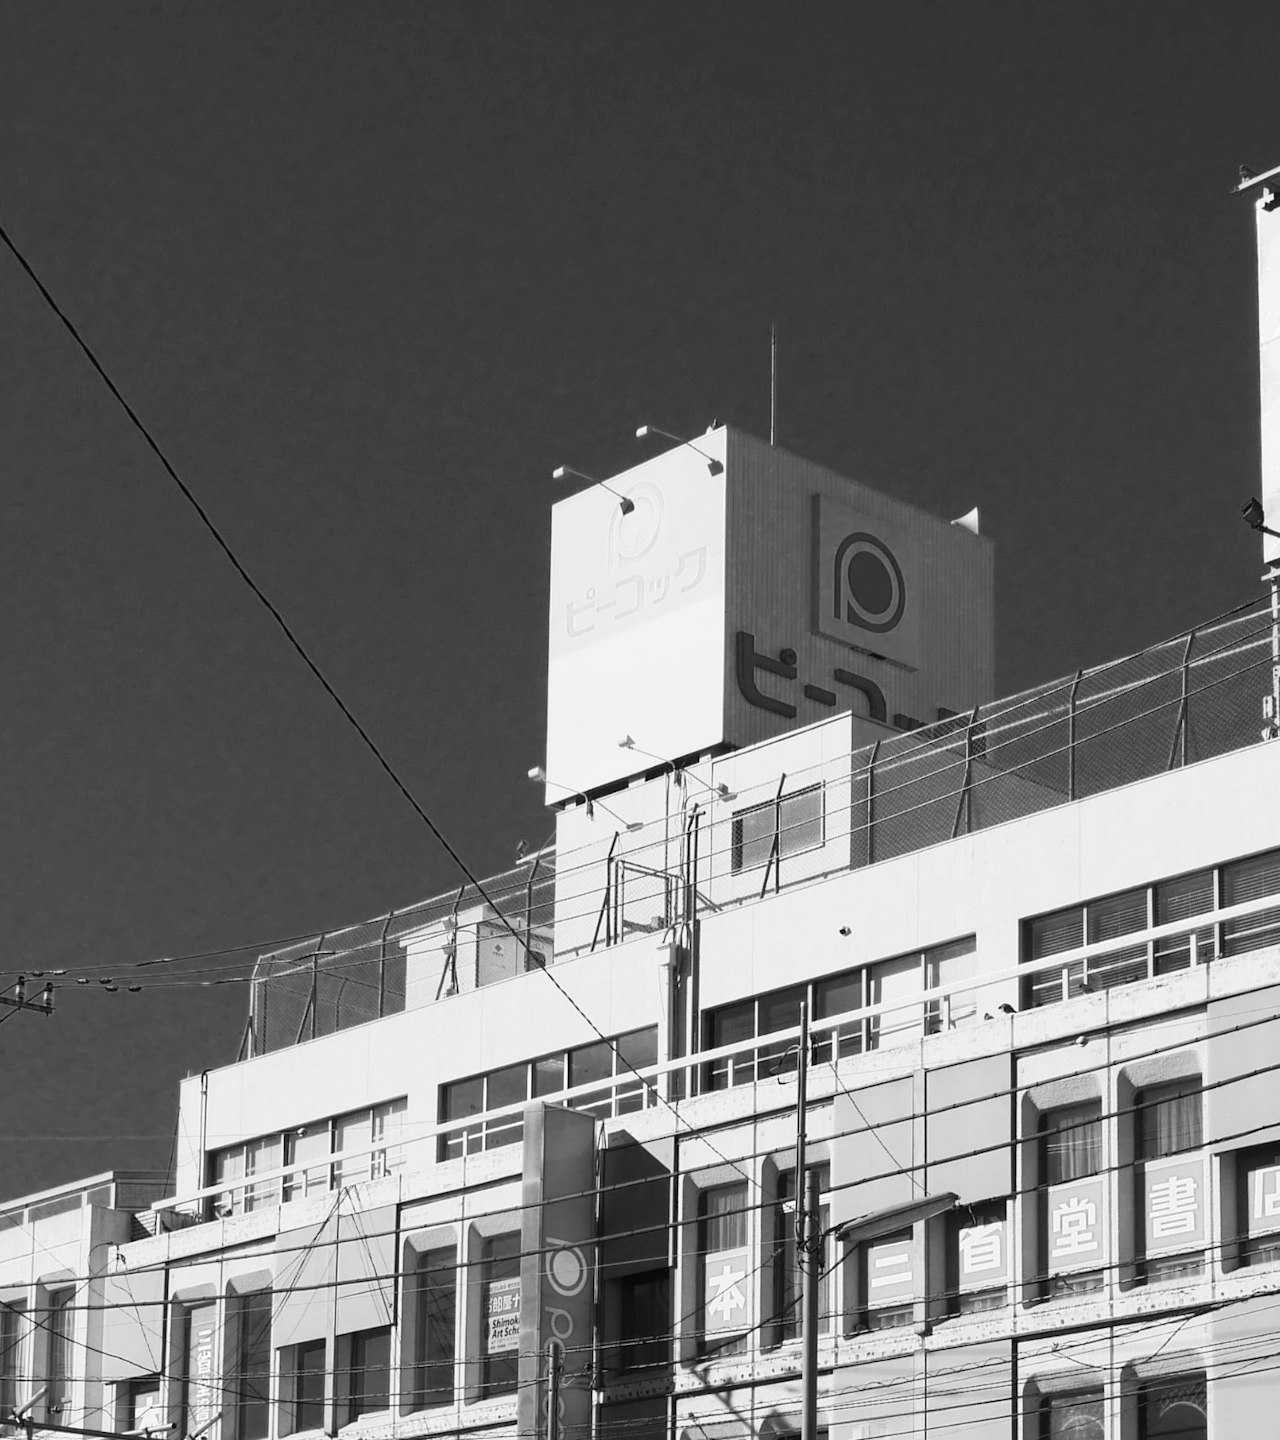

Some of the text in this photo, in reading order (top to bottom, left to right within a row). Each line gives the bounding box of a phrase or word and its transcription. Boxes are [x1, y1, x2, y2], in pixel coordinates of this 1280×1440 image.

[565, 545, 708, 638] ピーコック
[707, 1266, 747, 1320] 本
[492, 1315, 520, 1329] Shimok
[492, 1329, 503, 1339] Art
